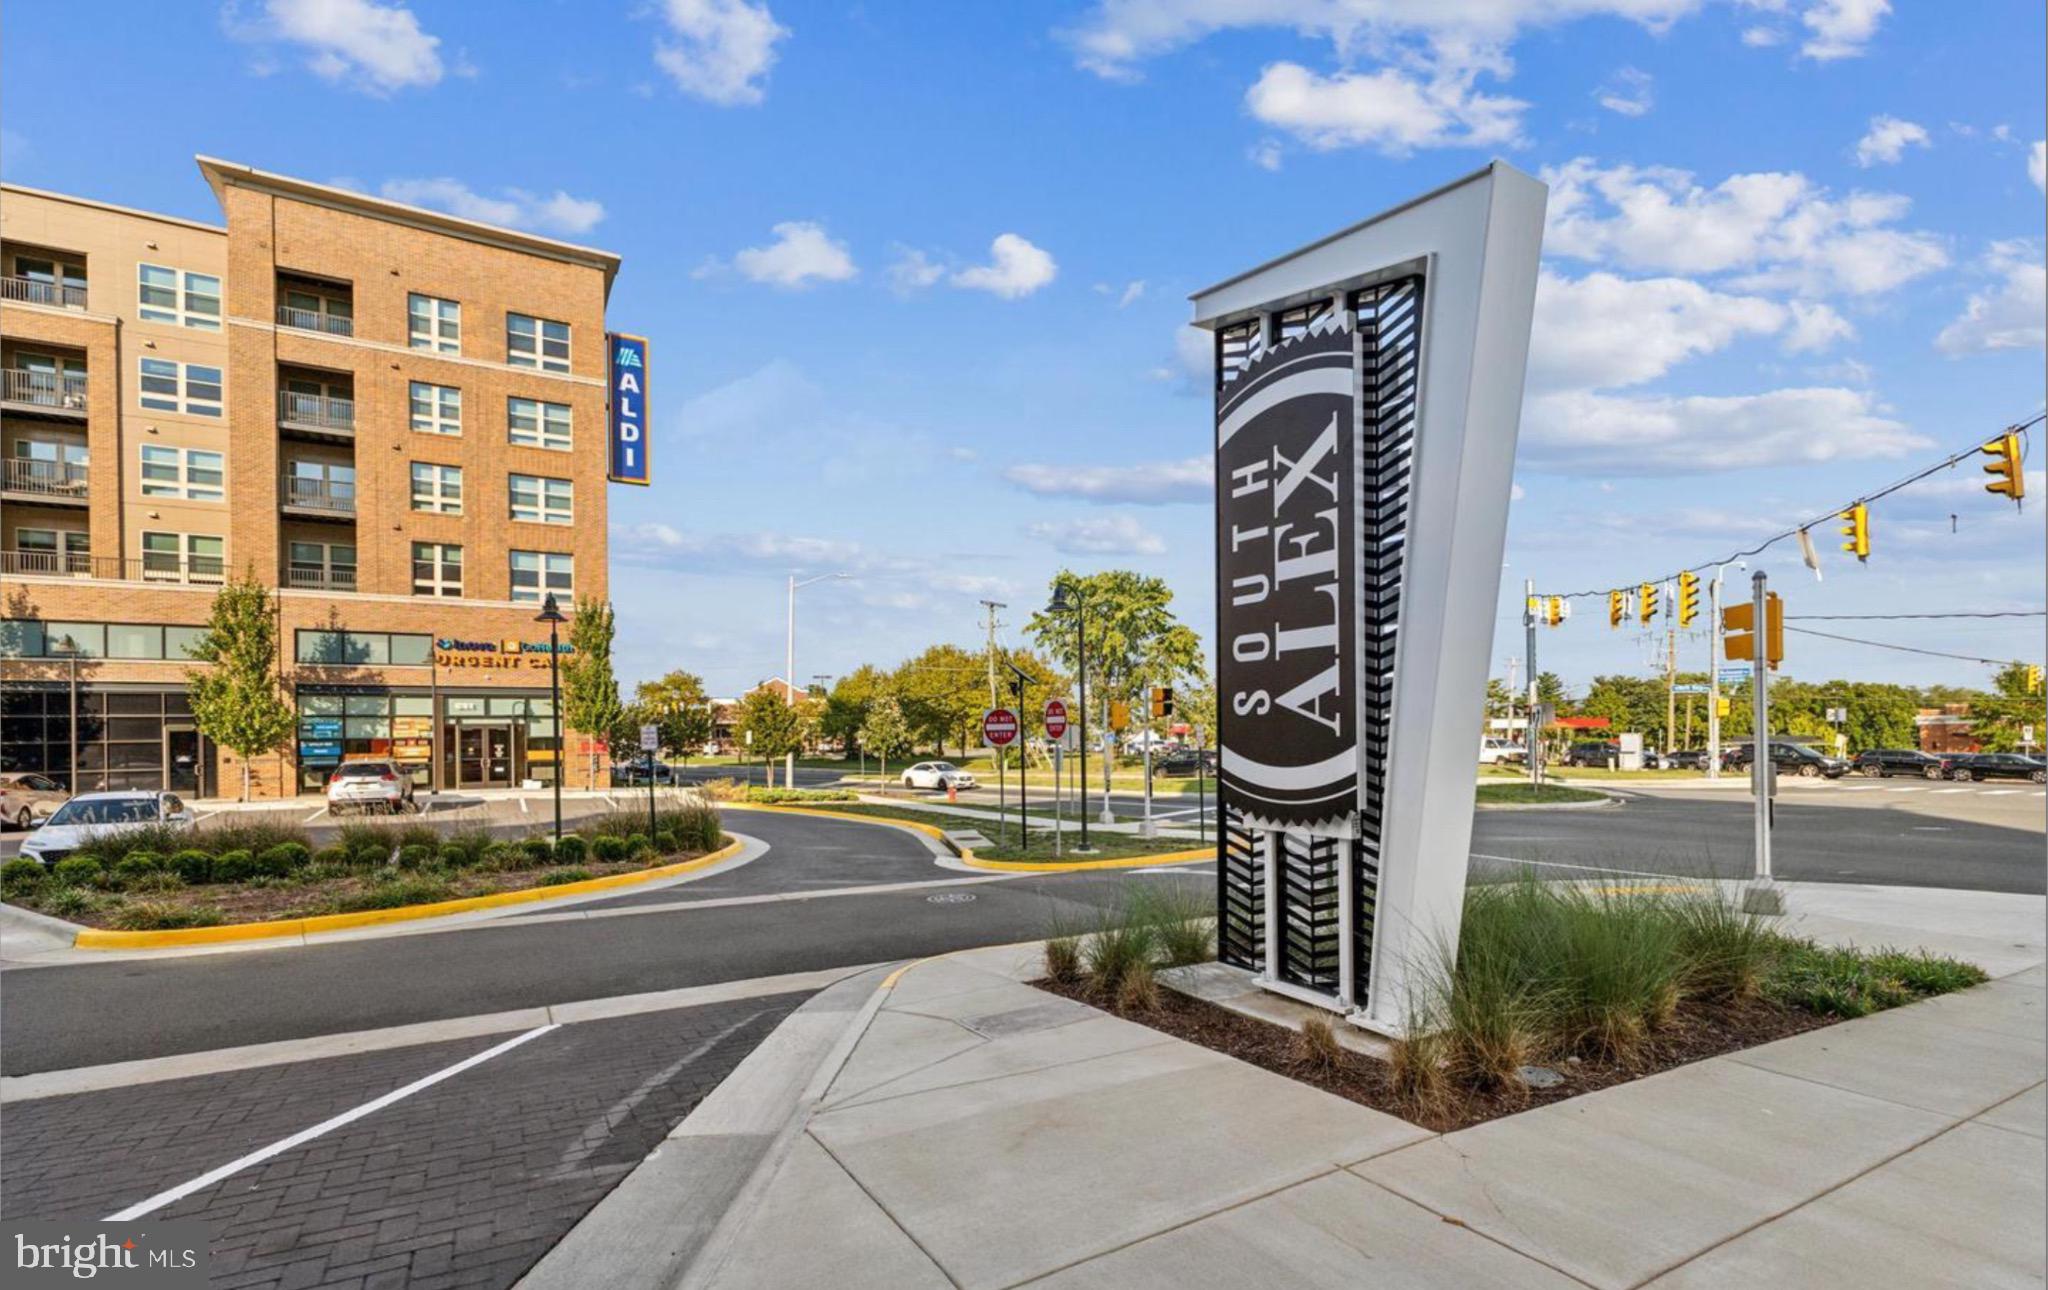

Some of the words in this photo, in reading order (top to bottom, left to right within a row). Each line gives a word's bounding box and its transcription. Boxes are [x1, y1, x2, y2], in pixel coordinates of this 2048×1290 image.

[620, 373, 640, 466] ALDI
[1232, 459, 1271, 715] SOUTH
[1273, 410, 1340, 737] ALEX
[435, 654, 522, 669] URGENT
